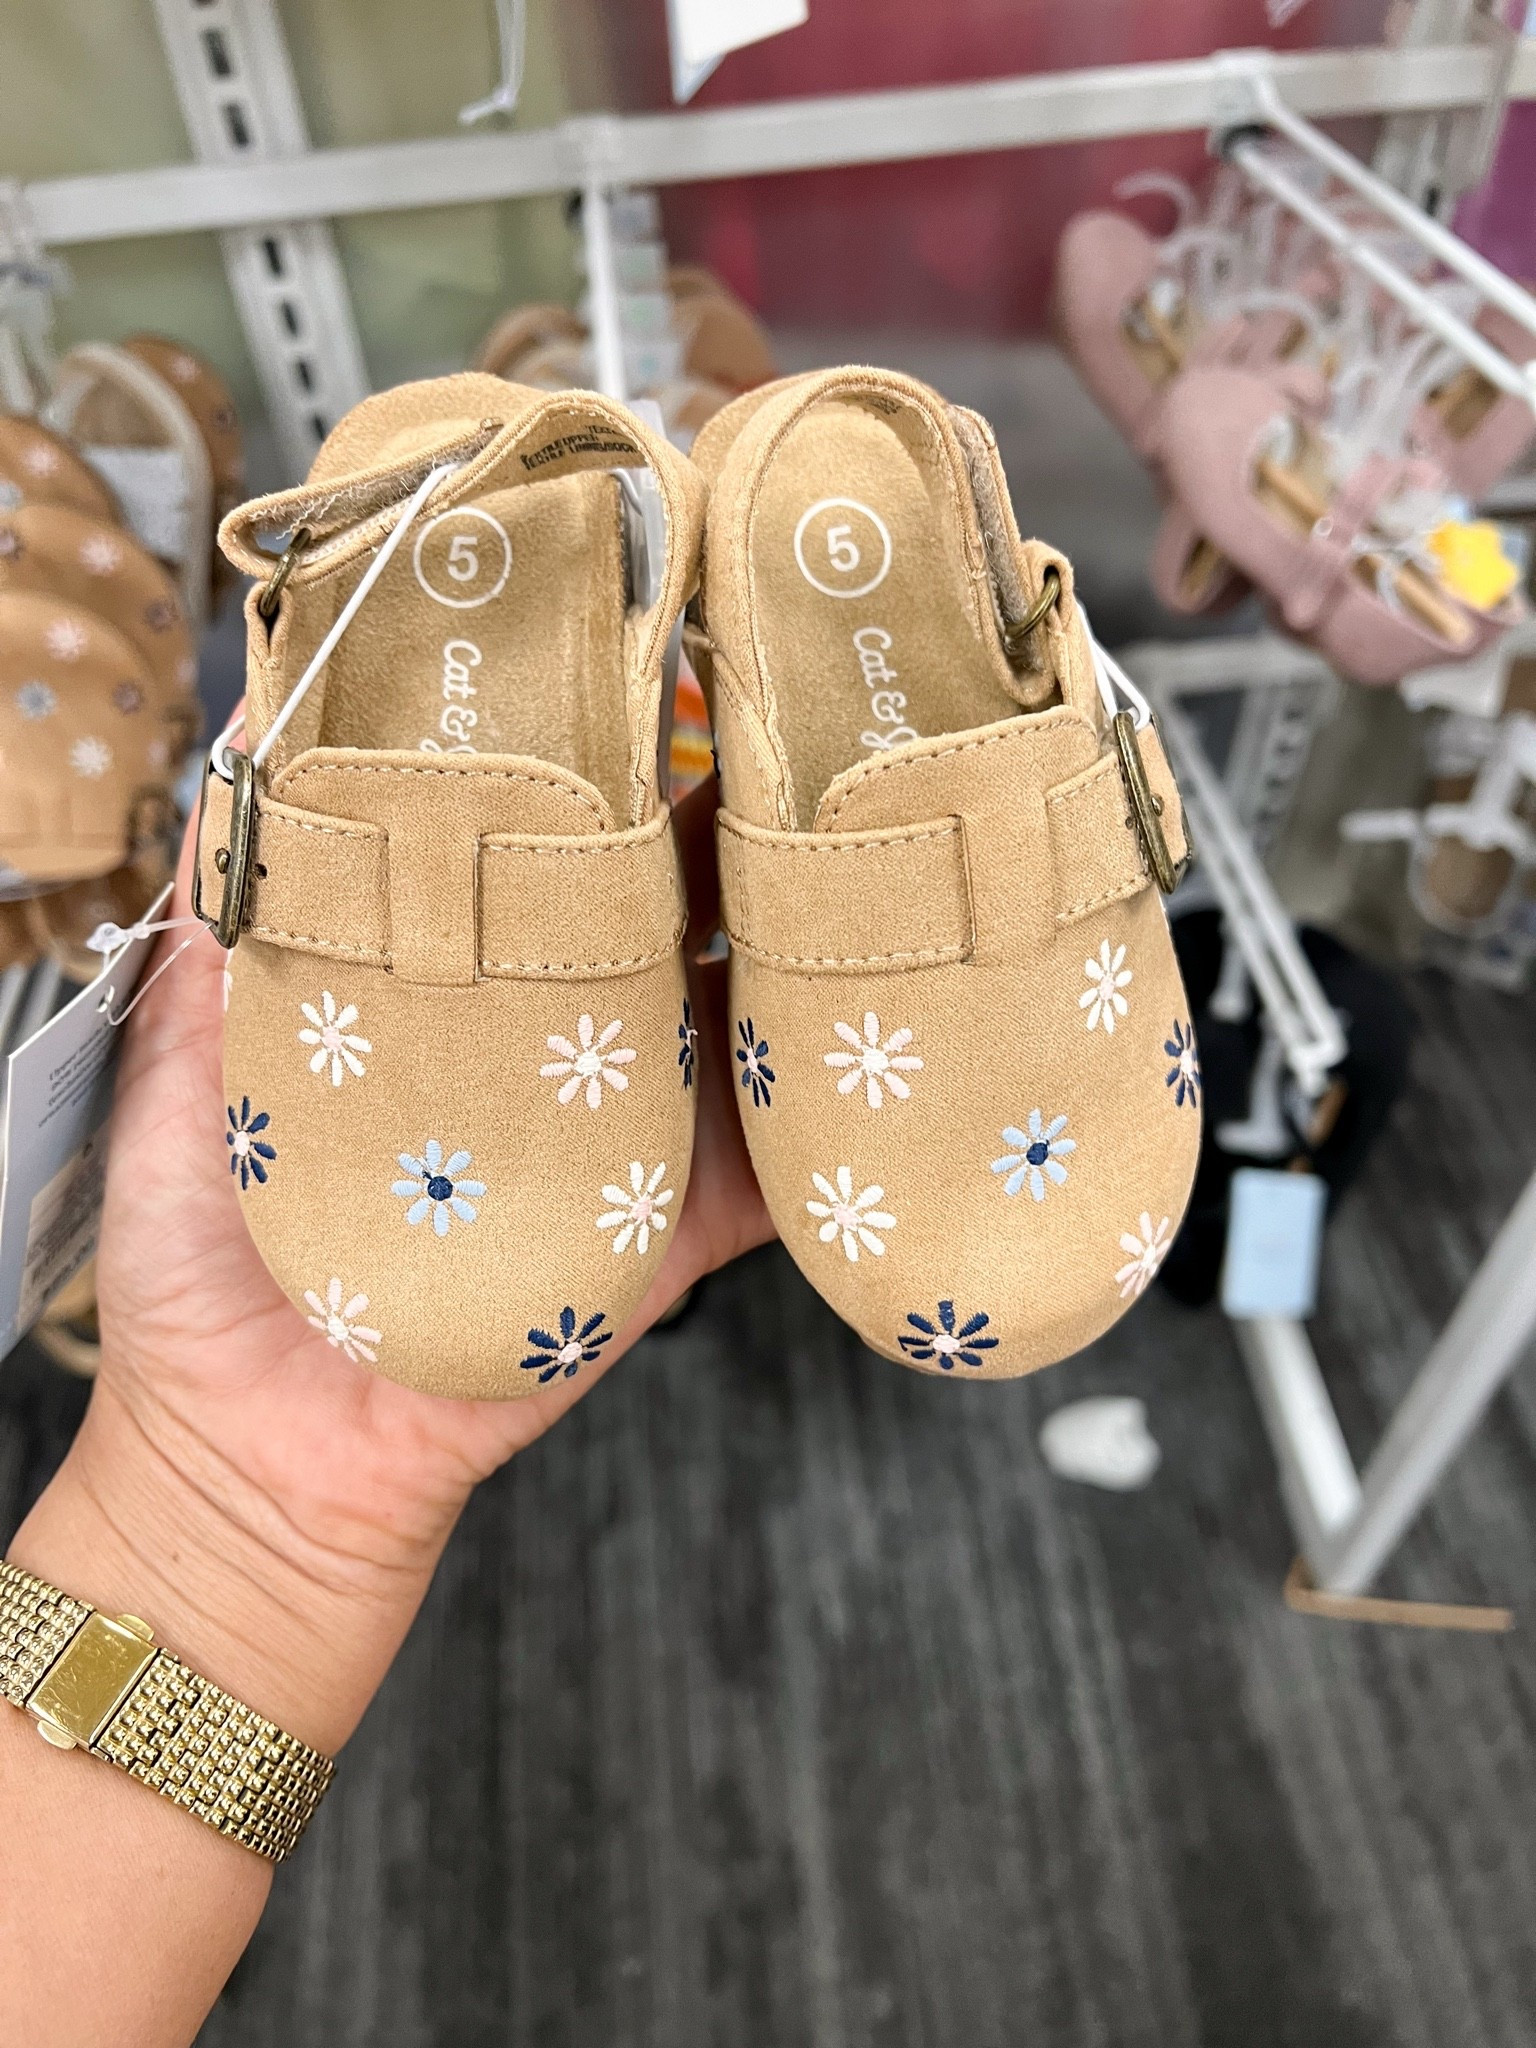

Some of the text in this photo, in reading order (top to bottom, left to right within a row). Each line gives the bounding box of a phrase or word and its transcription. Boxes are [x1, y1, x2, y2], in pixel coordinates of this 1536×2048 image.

[447, 536, 479, 581] 5
[827, 525, 860, 572] 5
[443, 640, 482, 700] Cat
[853, 627, 897, 688] Cat
[440, 705, 478, 742] &
[871, 690, 907, 724] &
